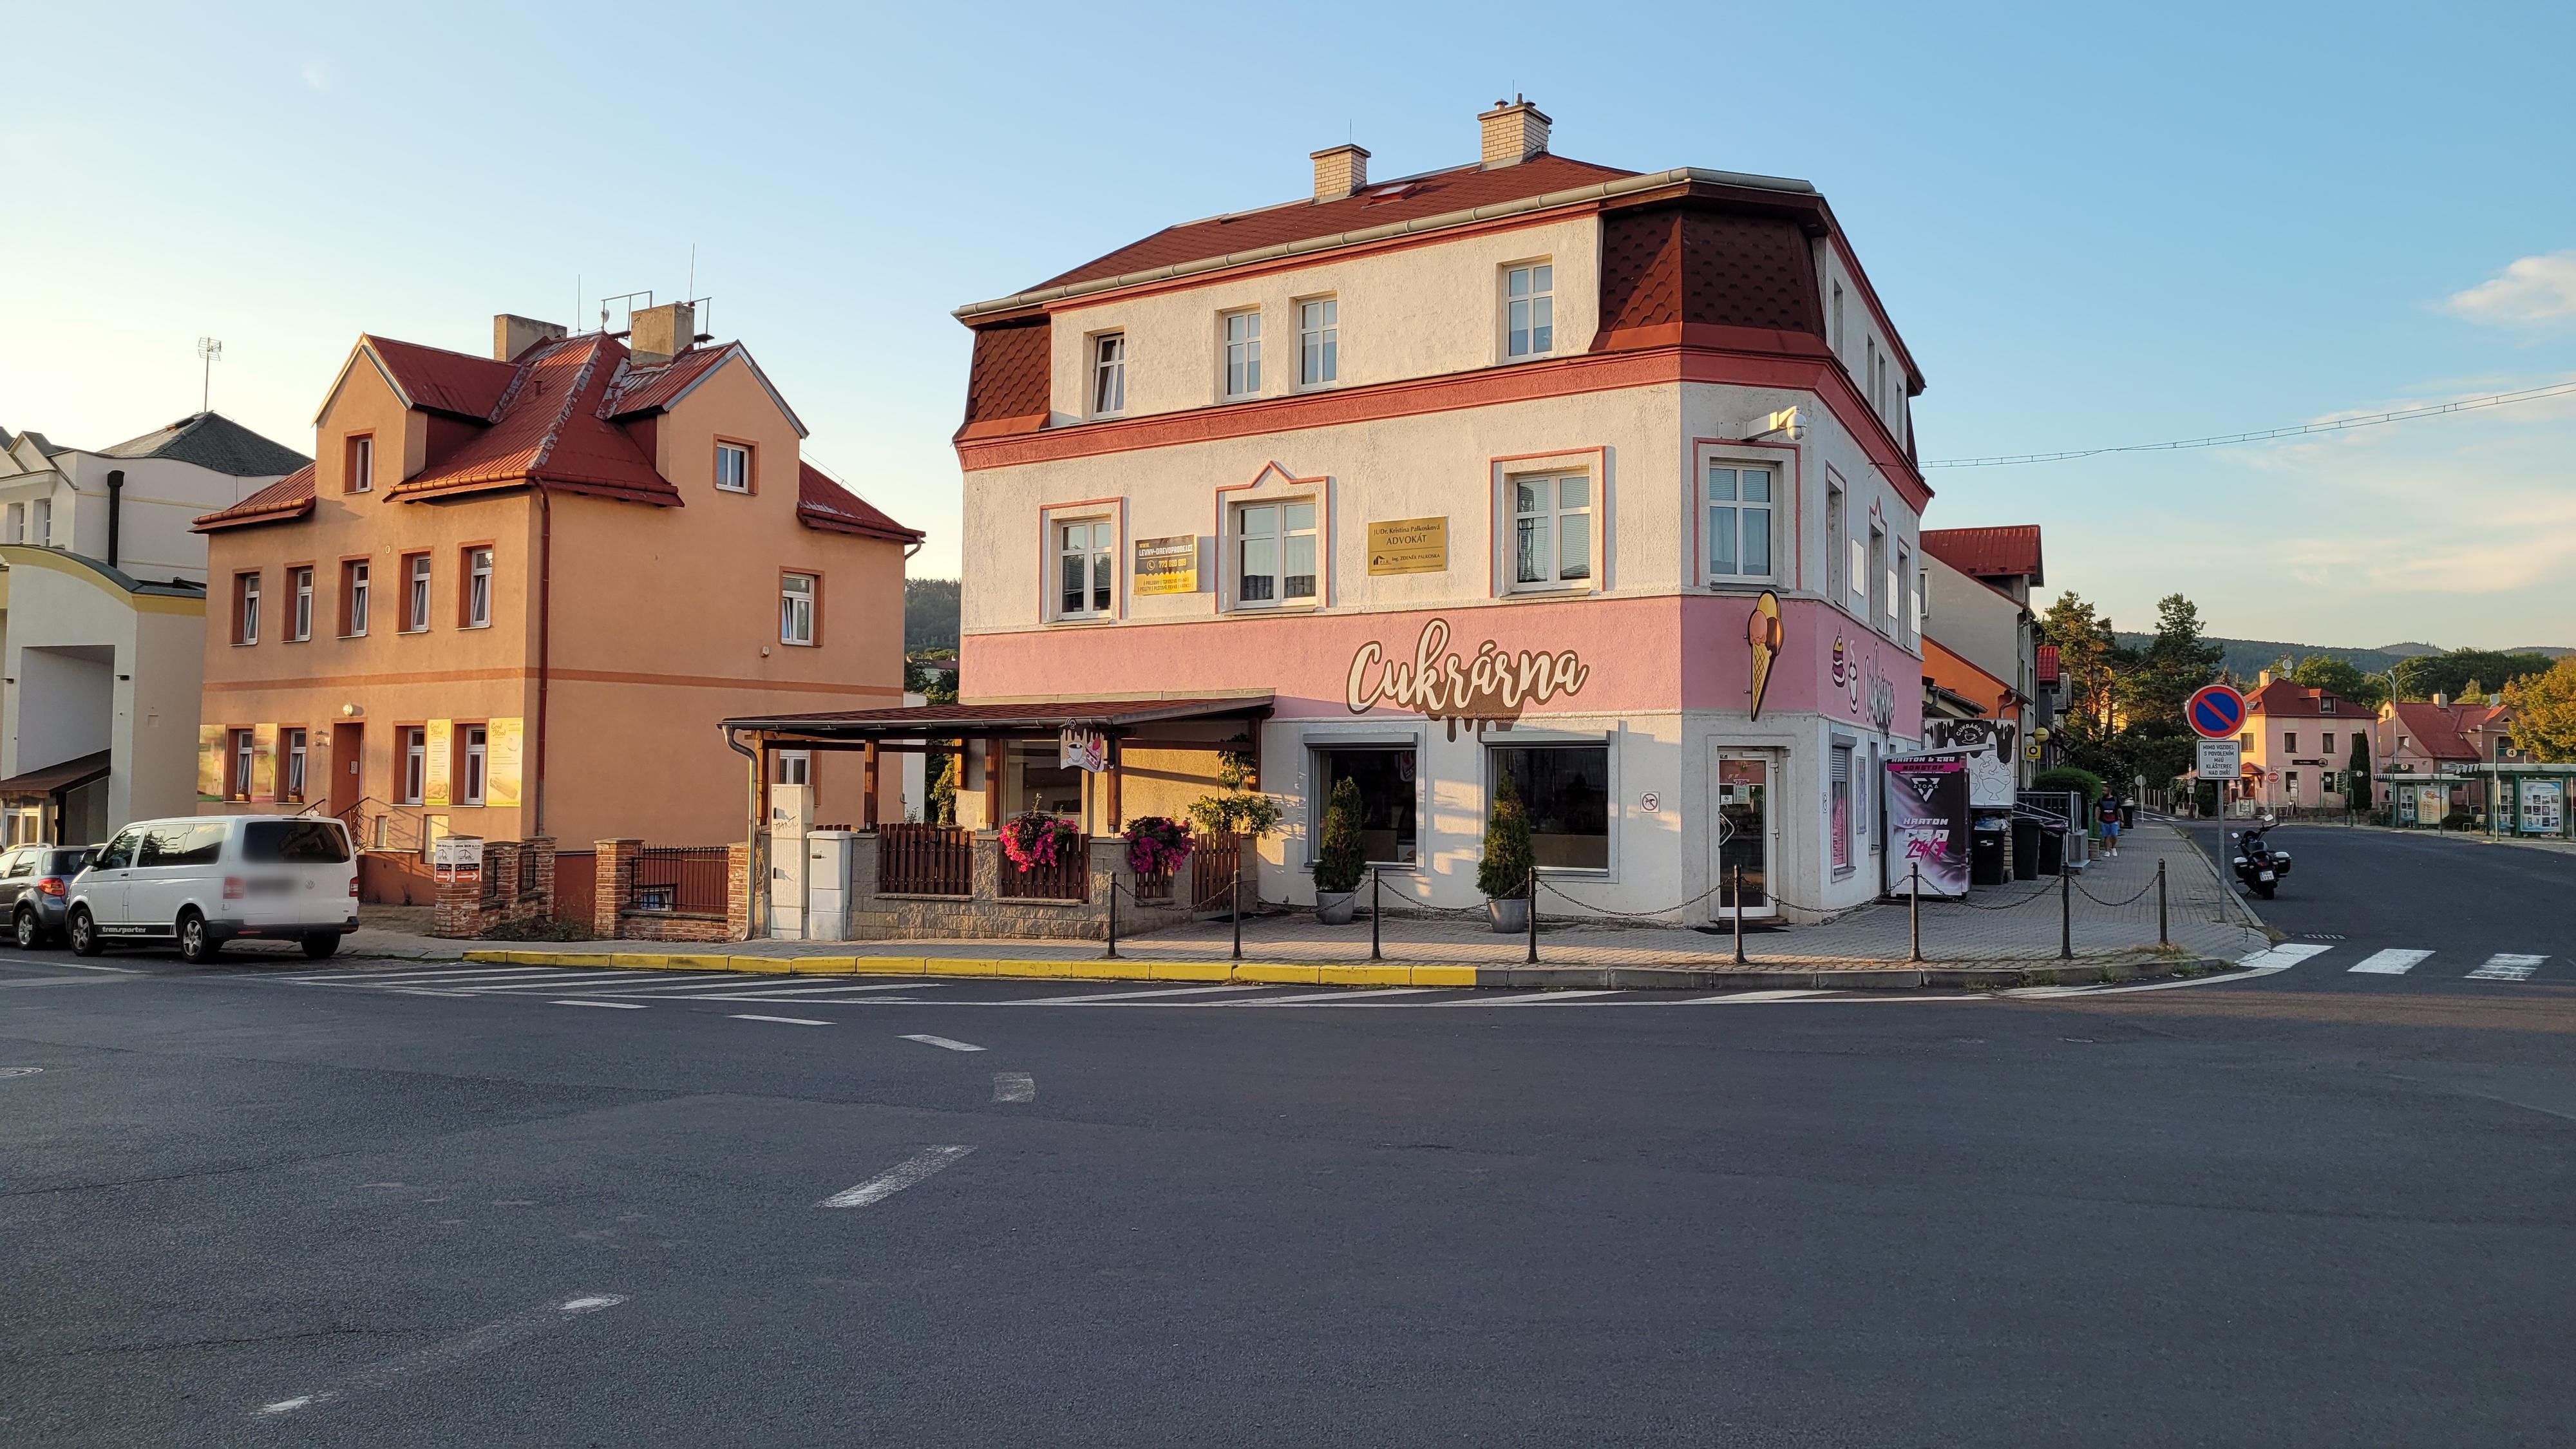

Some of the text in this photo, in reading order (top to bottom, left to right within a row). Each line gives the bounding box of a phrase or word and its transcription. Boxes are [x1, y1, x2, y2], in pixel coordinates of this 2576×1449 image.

[1386, 533, 1427, 546] ADVOKÁT
[1347, 618, 1589, 713] Cukrárna
[1956, 723, 1984, 737] CUKRÁRNA
[1904, 829, 1949, 842] CBD
[1905, 837, 1947, 862] 24/7
